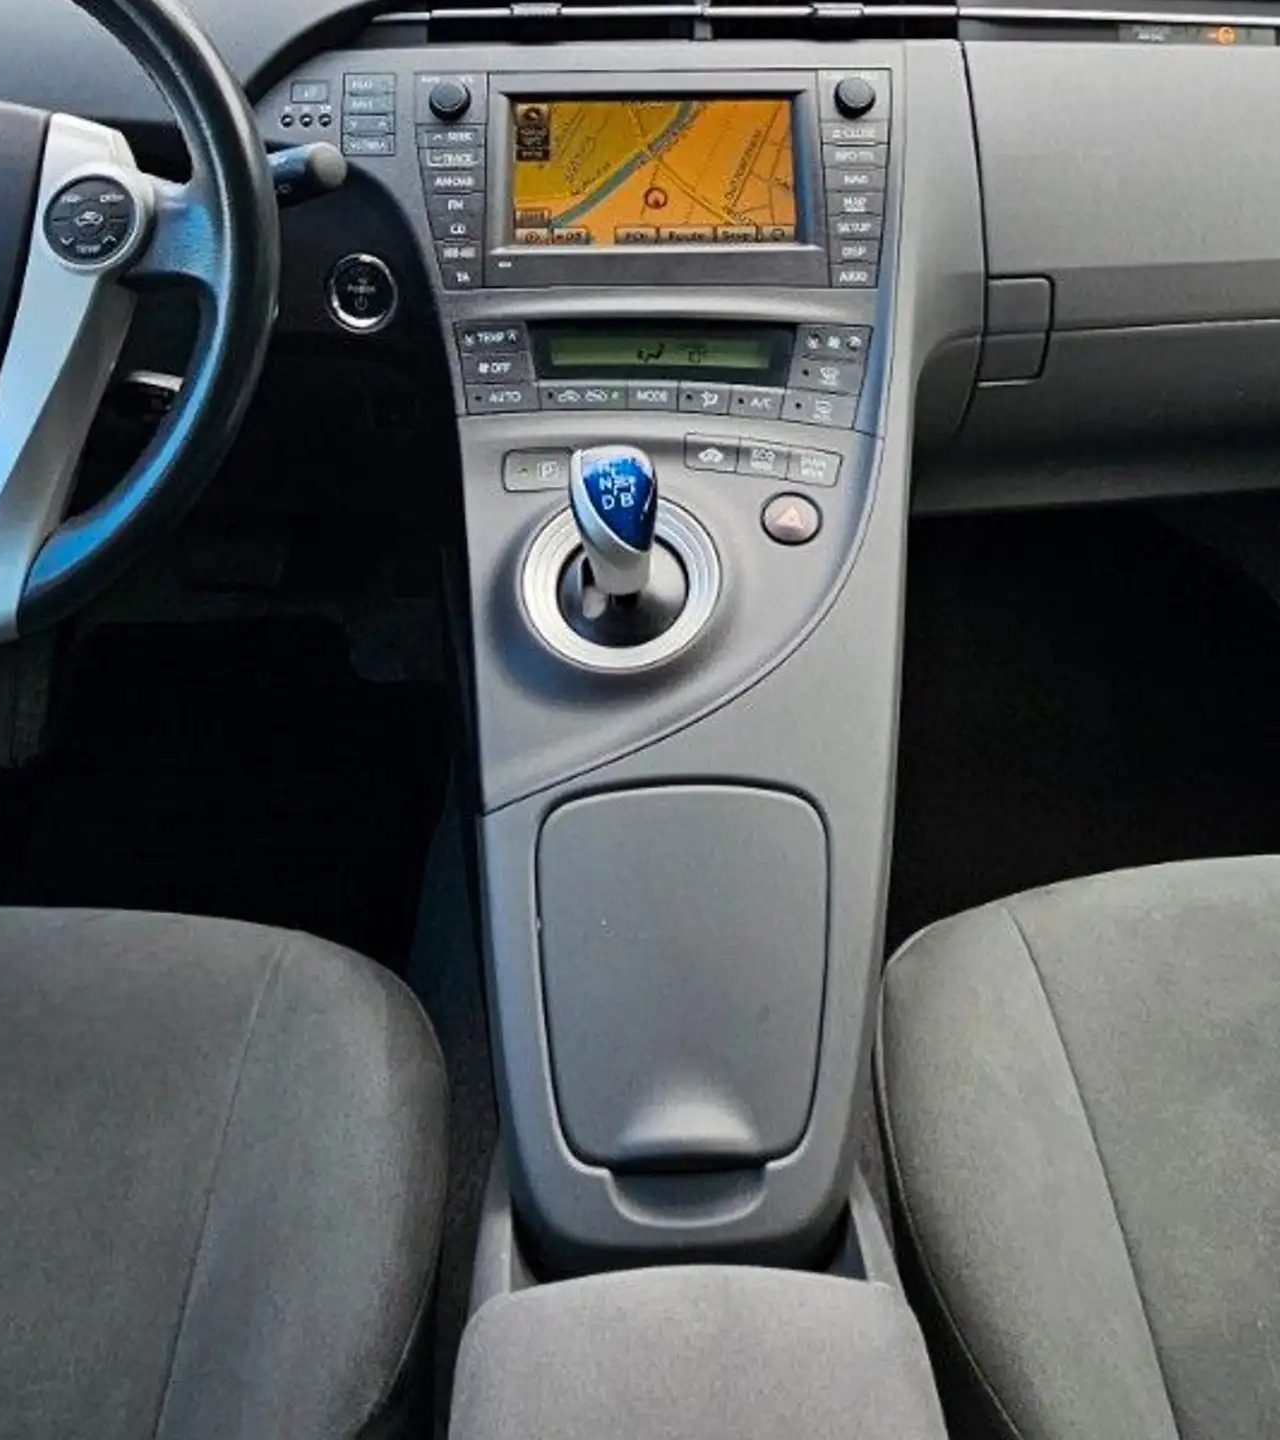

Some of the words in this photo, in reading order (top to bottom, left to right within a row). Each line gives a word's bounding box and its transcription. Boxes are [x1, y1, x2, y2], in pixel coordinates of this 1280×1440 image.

[488, 391, 522, 403] AUTO
[636, 389, 668, 402] MODE
[750, 397, 772, 409] A/C
[601, 494, 616, 510] D
[620, 491, 635, 508] B
